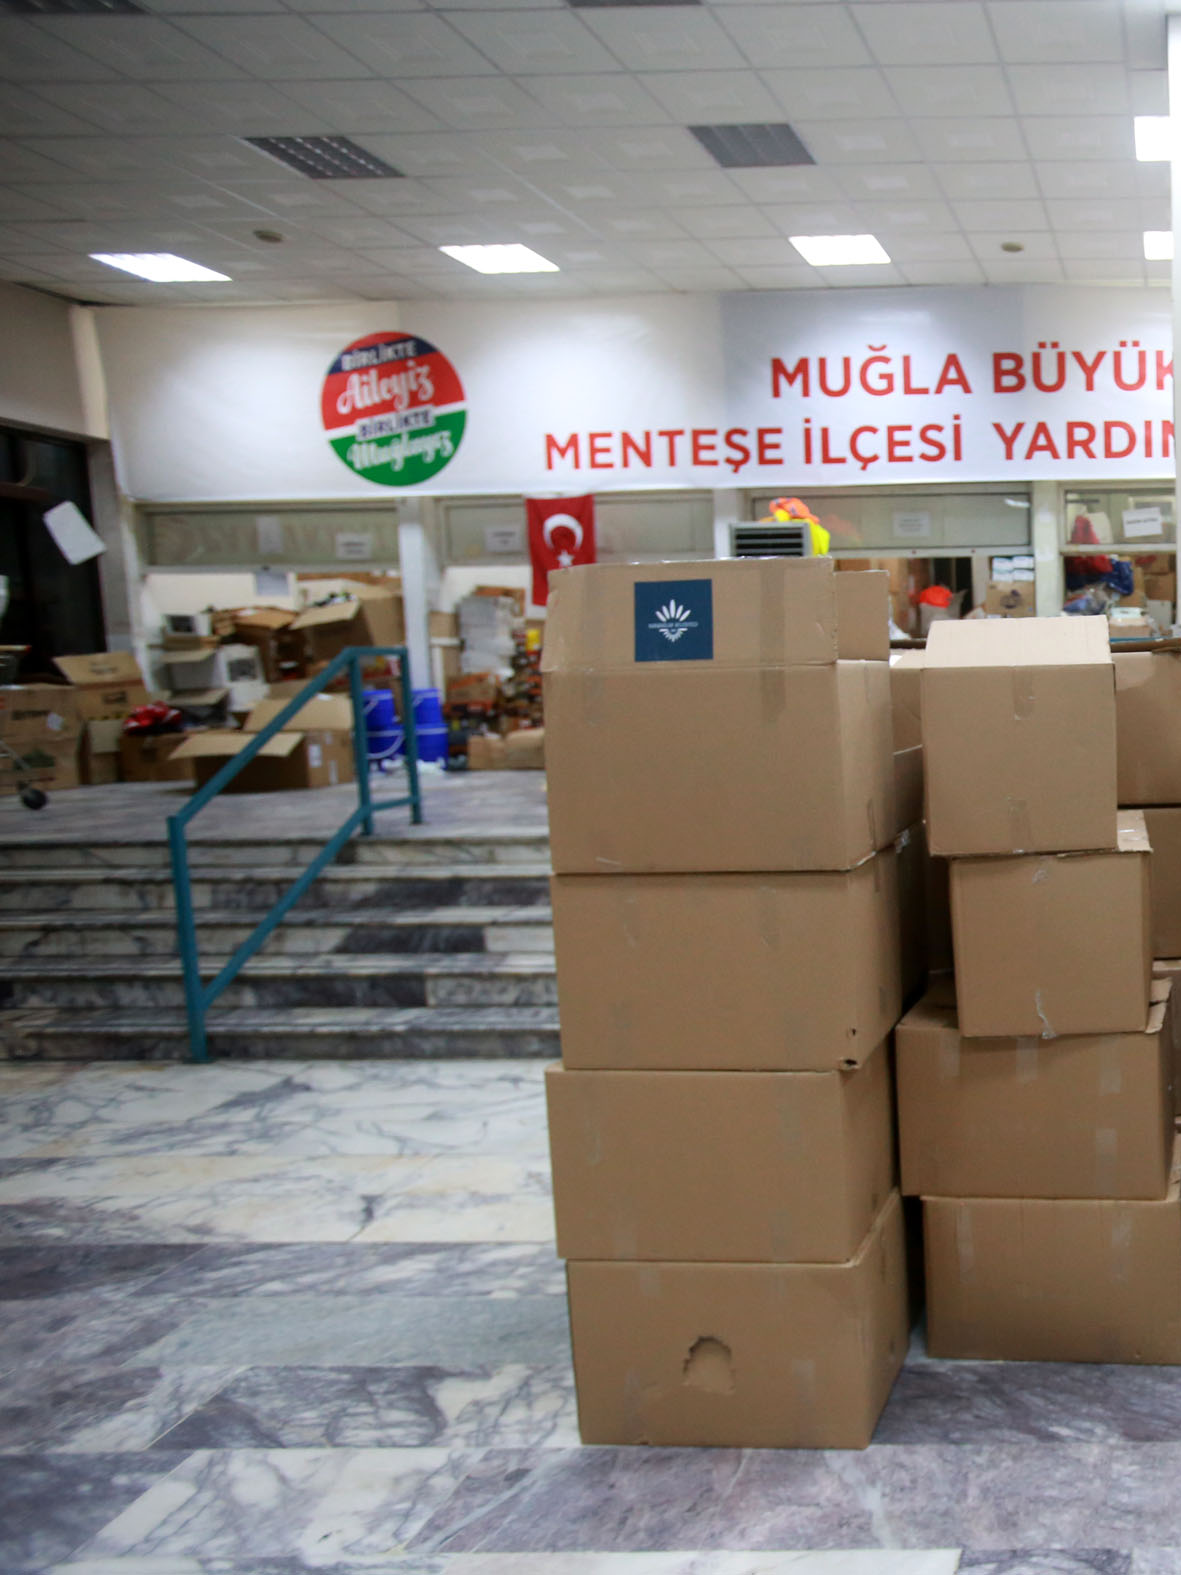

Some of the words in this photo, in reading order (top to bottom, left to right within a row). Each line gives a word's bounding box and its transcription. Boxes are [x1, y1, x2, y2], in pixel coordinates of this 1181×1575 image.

[336, 360, 434, 415] Aileyiz
[771, 345, 972, 398] MUĞLA
[545, 427, 784, 473] MENTEŞE
[803, 414, 962, 471] İLÇESİ
